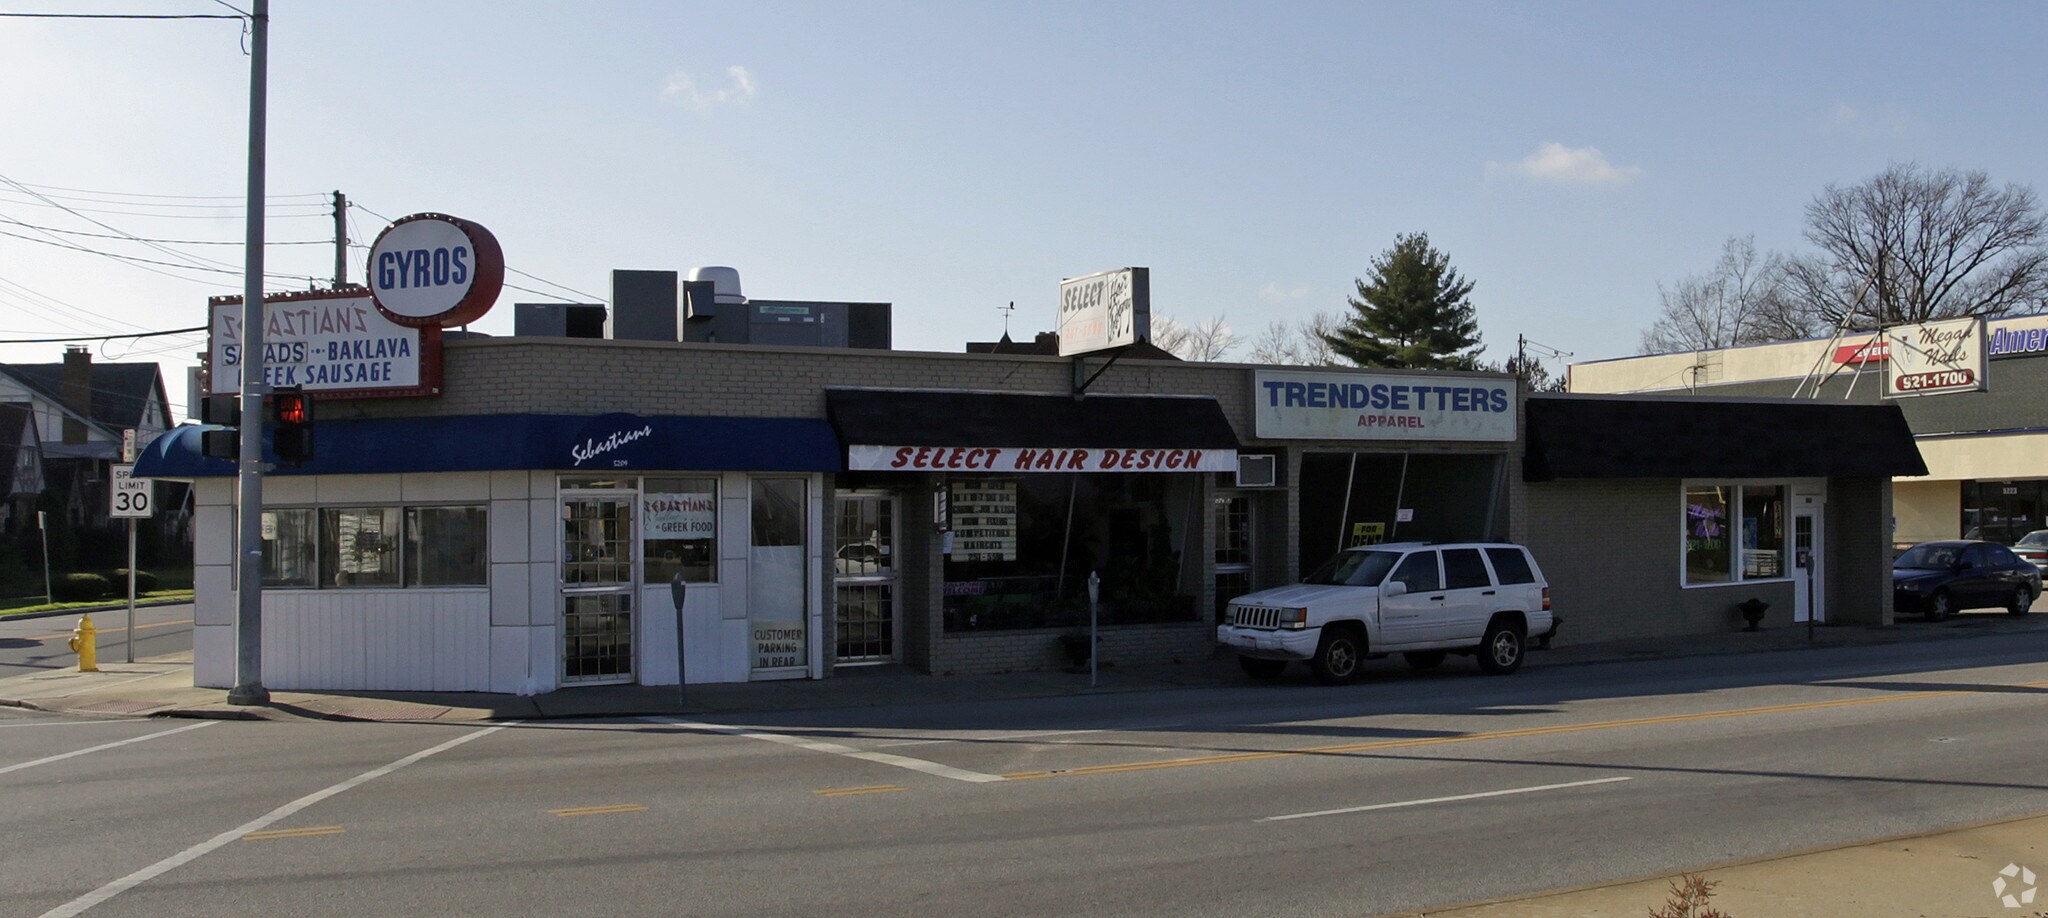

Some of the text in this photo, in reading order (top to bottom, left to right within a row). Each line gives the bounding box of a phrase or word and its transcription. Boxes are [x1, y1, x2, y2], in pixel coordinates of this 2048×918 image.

[379, 246, 467, 290] GYROS
[1063, 281, 1104, 313] SELECT
[222, 303, 367, 339] SASTIAN'S
[1919, 326, 1974, 345] Megan
[225, 338, 410, 365] SADS BAKLAVA
[1924, 346, 1968, 366] Nails
[237, 361, 391, 386] EEK SAUSAGE
[1903, 371, 1968, 389] 921-1700
[1263, 382, 1508, 412] TRENDSETTERS
[1357, 415, 1425, 428] APPAREL
[571, 425, 653, 466] Sebastians
[890, 448, 1202, 470] SELECT HAIR DESIGN
[116, 492, 147, 511] 30
[661, 522, 713, 533] GREEK FOOD
[1361, 525, 1377, 533] FOR
[755, 629, 802, 640] CUSTOMER
[758, 643, 797, 653] PARKING
[760, 656, 769, 668] IN
